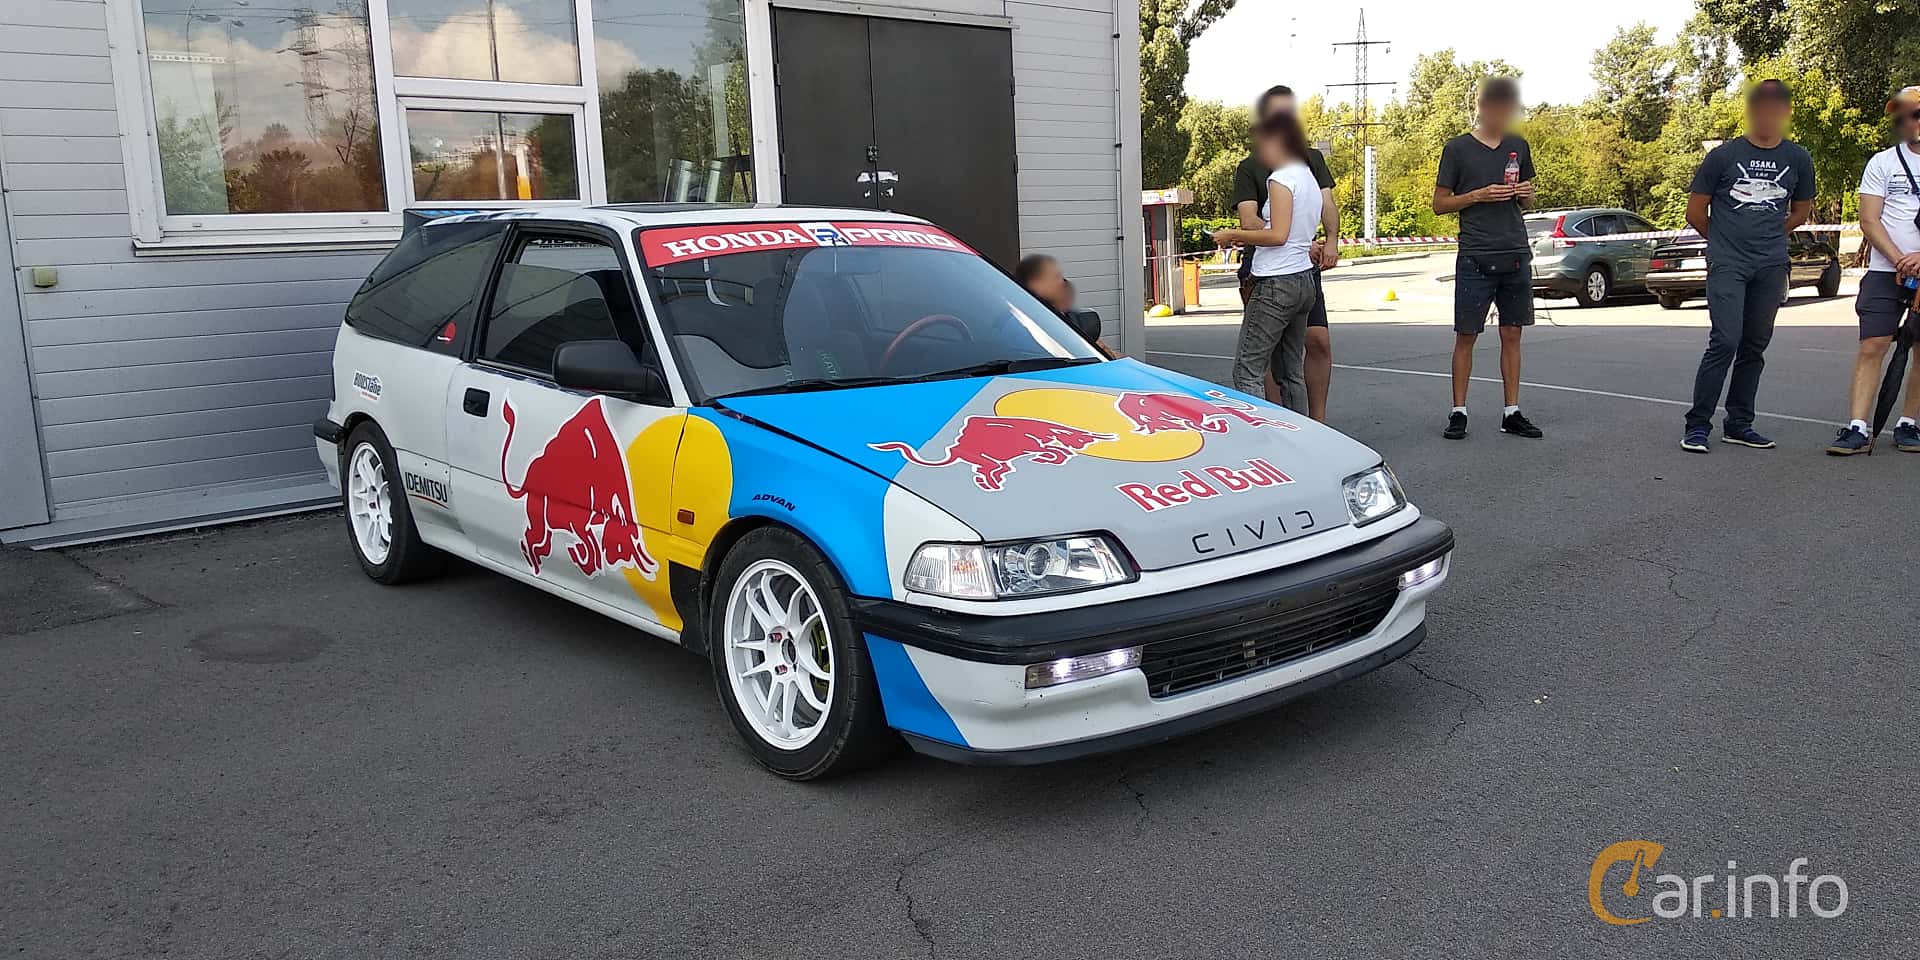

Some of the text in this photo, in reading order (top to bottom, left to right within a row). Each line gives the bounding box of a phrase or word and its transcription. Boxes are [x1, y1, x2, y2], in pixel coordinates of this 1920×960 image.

[1750, 160, 1777, 169] OSAKA
[662, 229, 813, 257] HONDA
[840, 228, 957, 248] PRIMO
[405, 471, 448, 503] IDEMITSU
[1116, 457, 1296, 512] Red Bull
[752, 494, 796, 512] ADVAN
